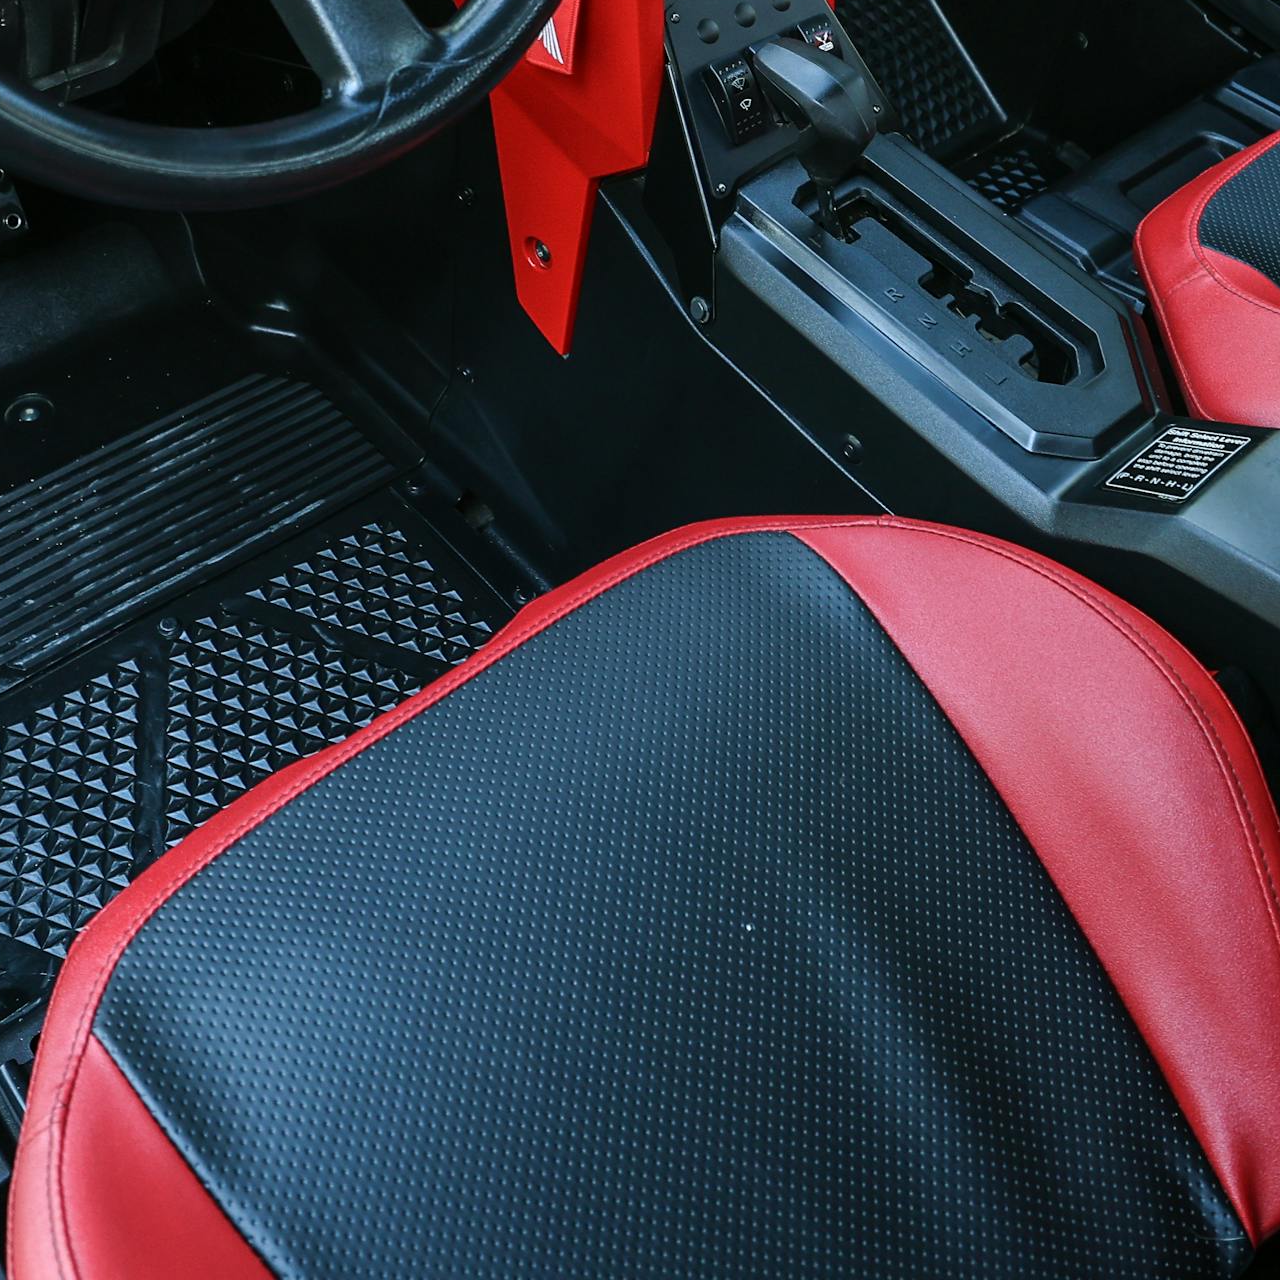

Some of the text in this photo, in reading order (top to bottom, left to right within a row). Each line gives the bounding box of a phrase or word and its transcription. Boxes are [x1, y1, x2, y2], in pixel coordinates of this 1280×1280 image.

[883, 287, 905, 304] R
[1167, 429, 1246, 445] Shift Select Lever
[1172, 437, 1225, 449] Information
